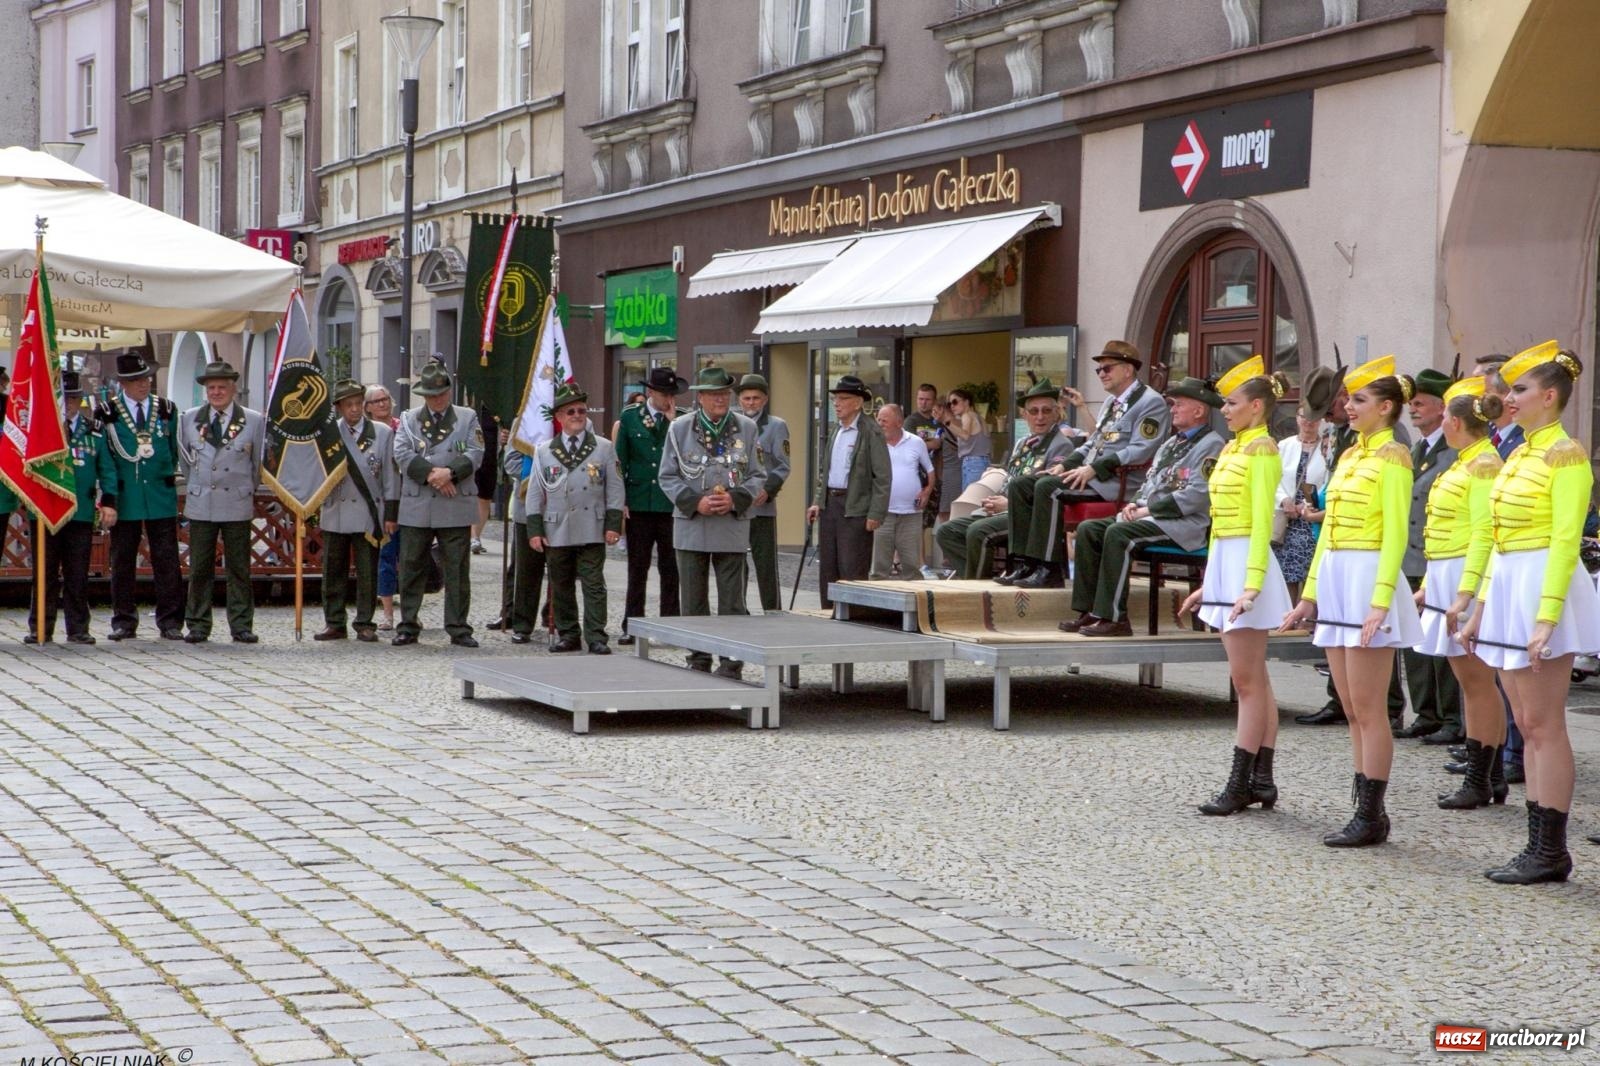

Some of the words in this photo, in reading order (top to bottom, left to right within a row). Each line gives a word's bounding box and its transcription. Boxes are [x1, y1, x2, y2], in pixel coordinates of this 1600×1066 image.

[768, 185, 866, 237] Manufaktura
[868, 173, 931, 223] Lodów
[934, 153, 1020, 213] Gałeczka
[13, 263, 69, 283] Loów
[73, 269, 144, 292] Gałeczka
[614, 285, 668, 330] żabka
